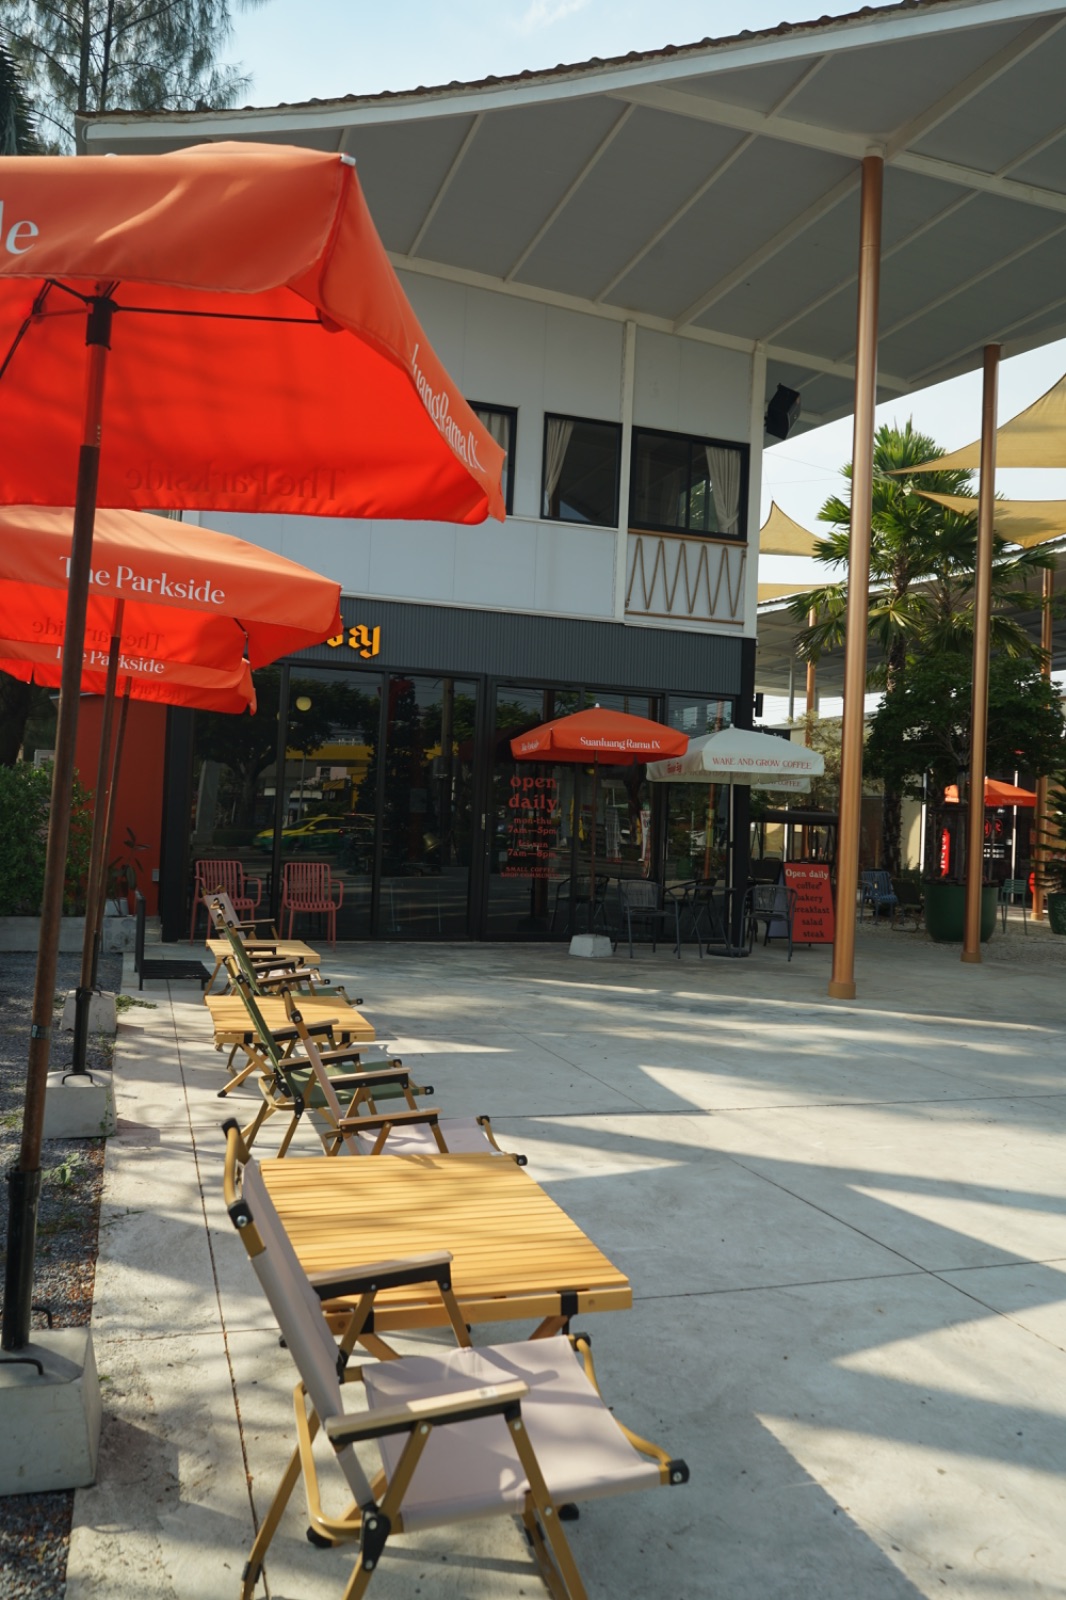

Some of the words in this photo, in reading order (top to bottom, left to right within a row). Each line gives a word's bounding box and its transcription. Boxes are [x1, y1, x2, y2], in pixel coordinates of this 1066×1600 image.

[115, 565, 226, 604] Parkside
[90, 650, 165, 674] Pakside
[626, 739, 650, 749] Rama
[651, 740, 661, 749] IX
[712, 757, 736, 766] WAKE
[737, 758, 754, 766] AND
[755, 759, 779, 767] GROW
[782, 761, 812, 770] COFFEE
[510, 776, 558, 791] open
[508, 793, 558, 813] daily
[785, 869, 807, 878] Open
[809, 870, 829, 880] daily
[801, 917, 823, 926] salad
[803, 930, 825, 938] steak
